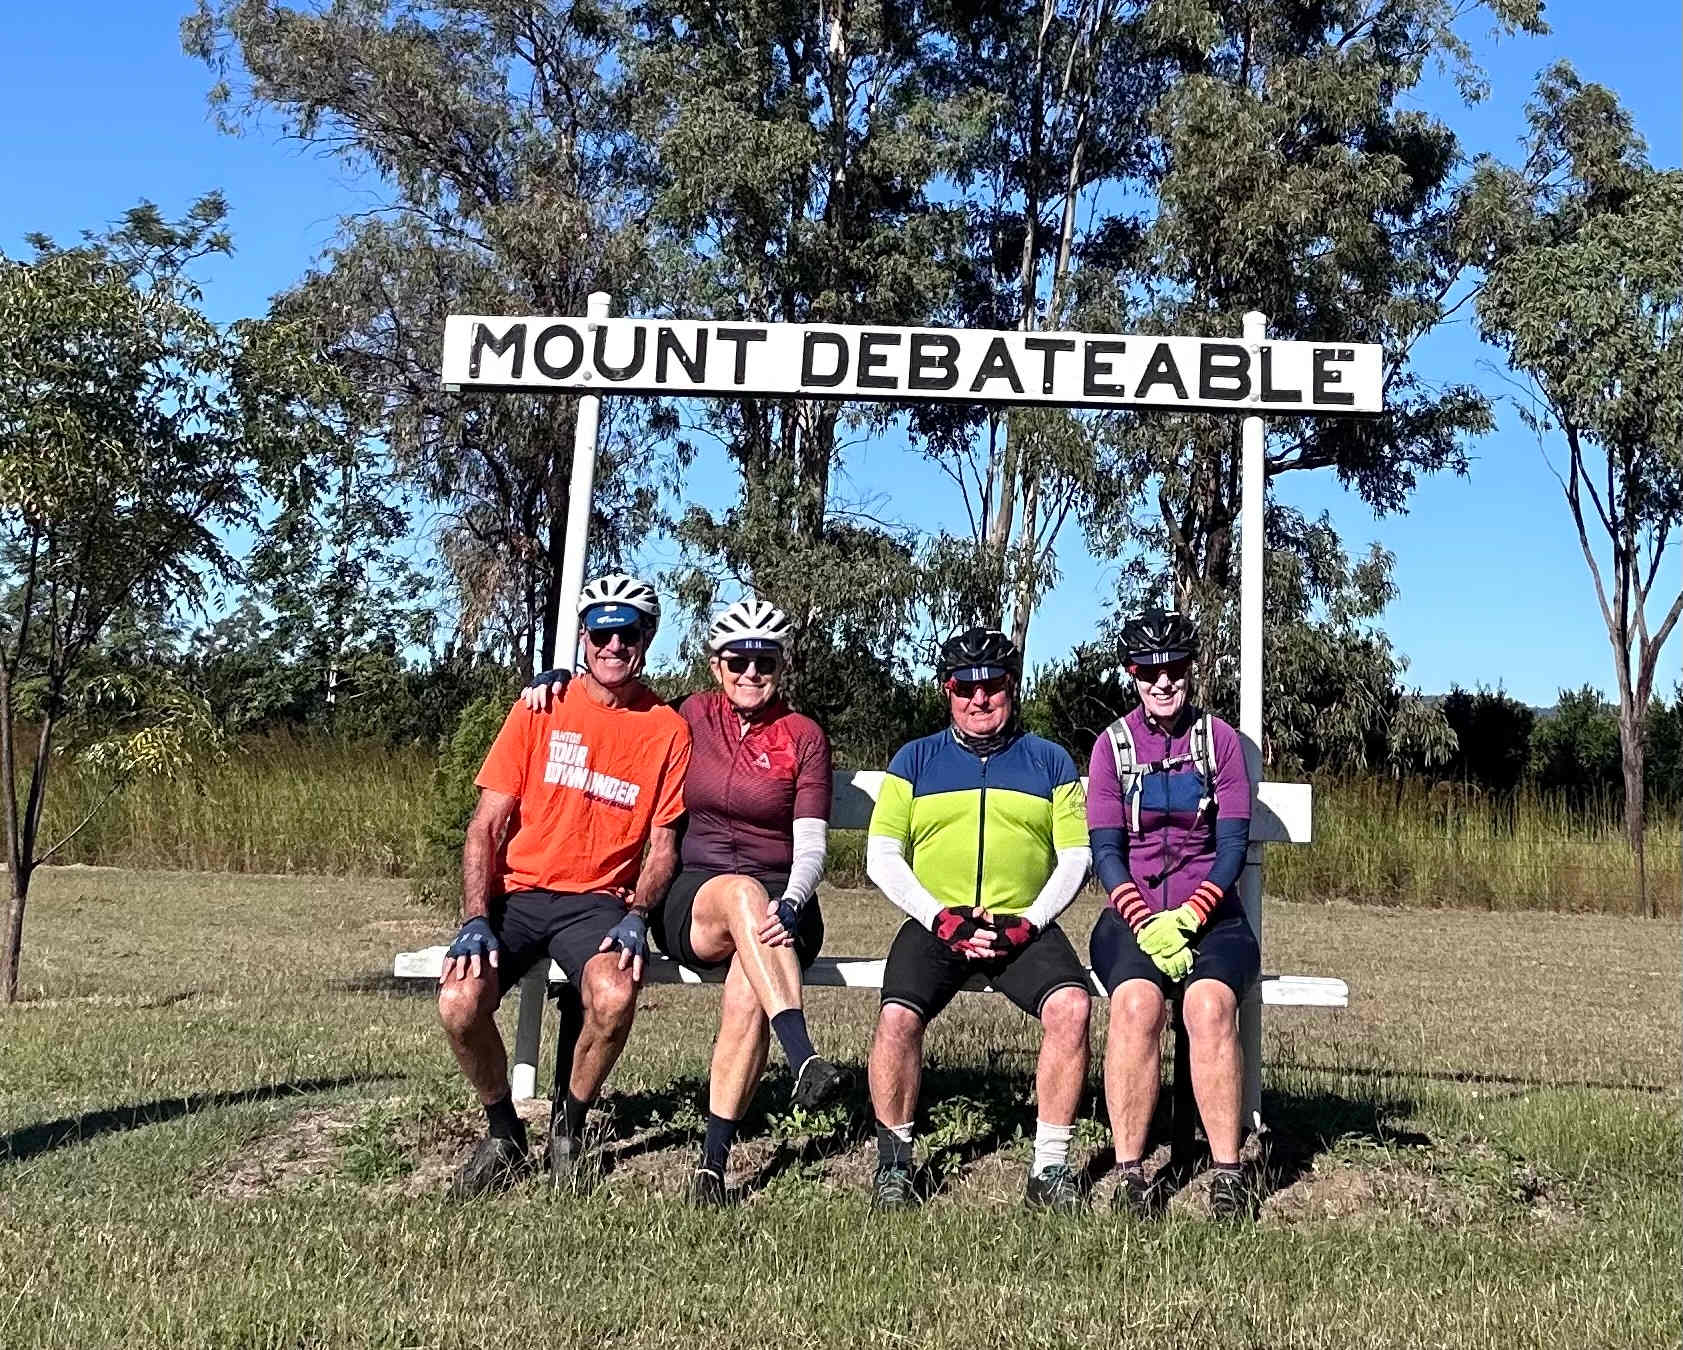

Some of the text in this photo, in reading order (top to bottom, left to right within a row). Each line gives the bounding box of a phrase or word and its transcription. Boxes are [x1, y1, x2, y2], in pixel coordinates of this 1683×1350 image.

[469, 322, 1355, 405] MOUNT DEBATEABLE
[549, 741, 589, 767] TOUR
